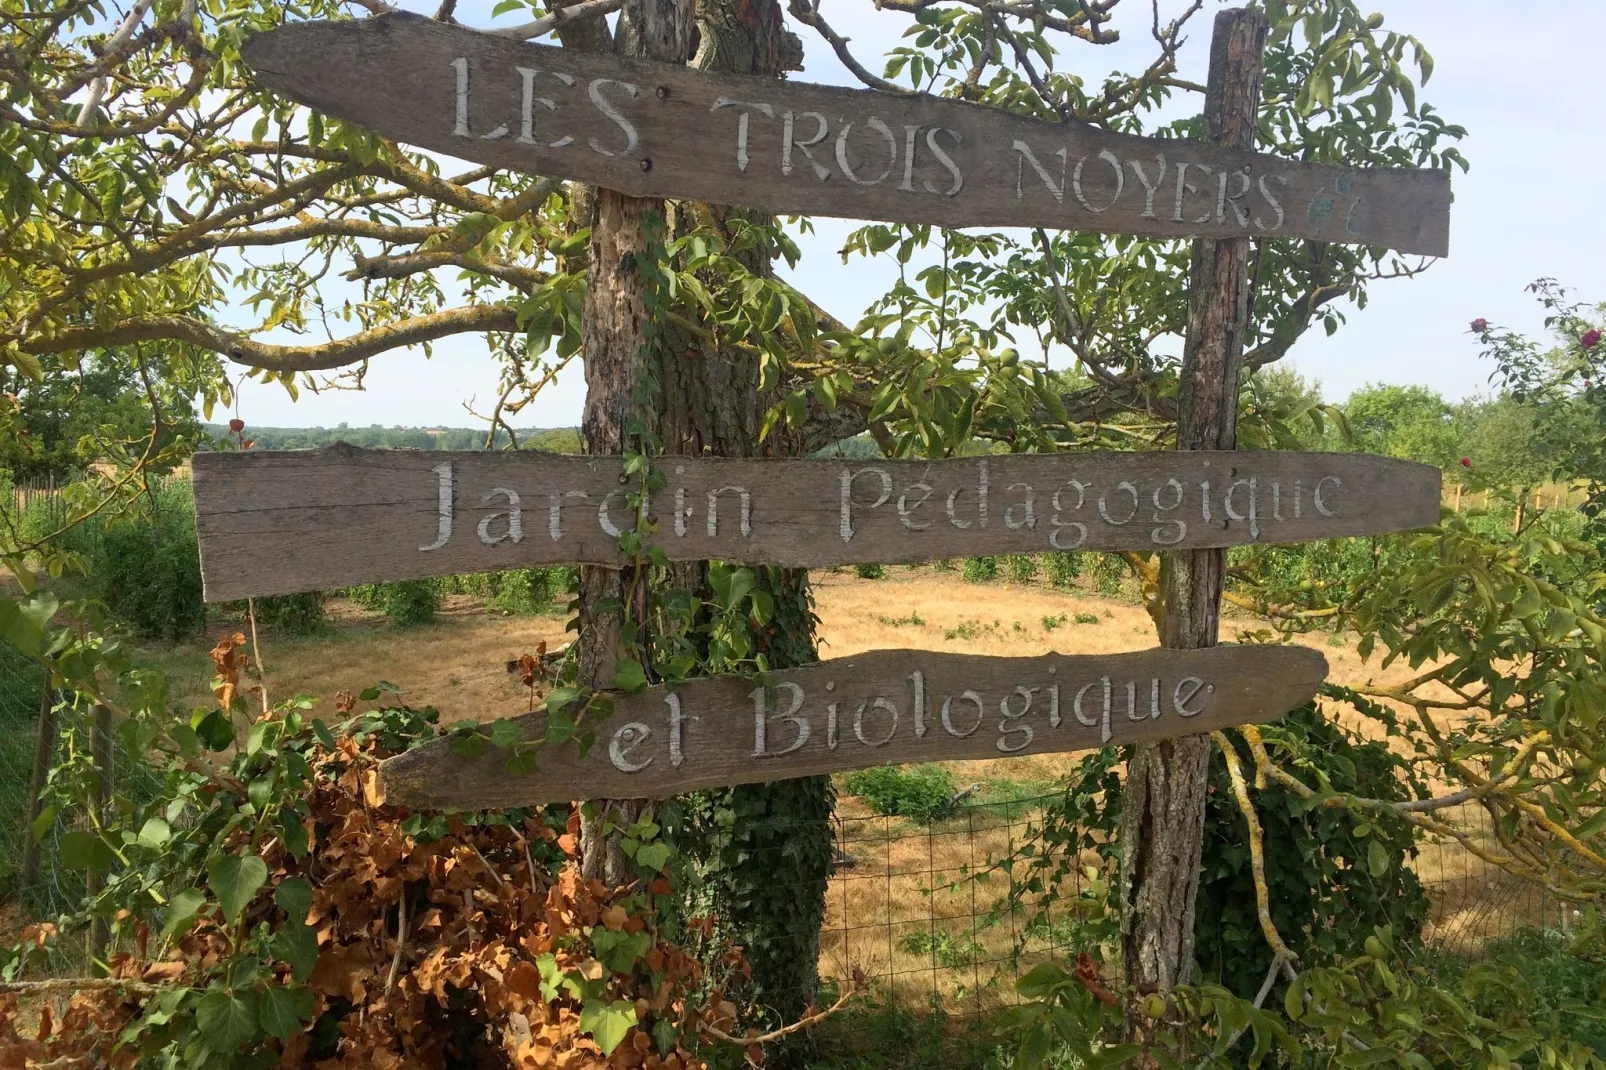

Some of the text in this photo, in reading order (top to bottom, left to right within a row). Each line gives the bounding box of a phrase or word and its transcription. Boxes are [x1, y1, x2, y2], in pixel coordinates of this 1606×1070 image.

[450, 57, 1287, 232] LES TROIS NOYERS
[609, 665, 1206, 773] et Biologique
